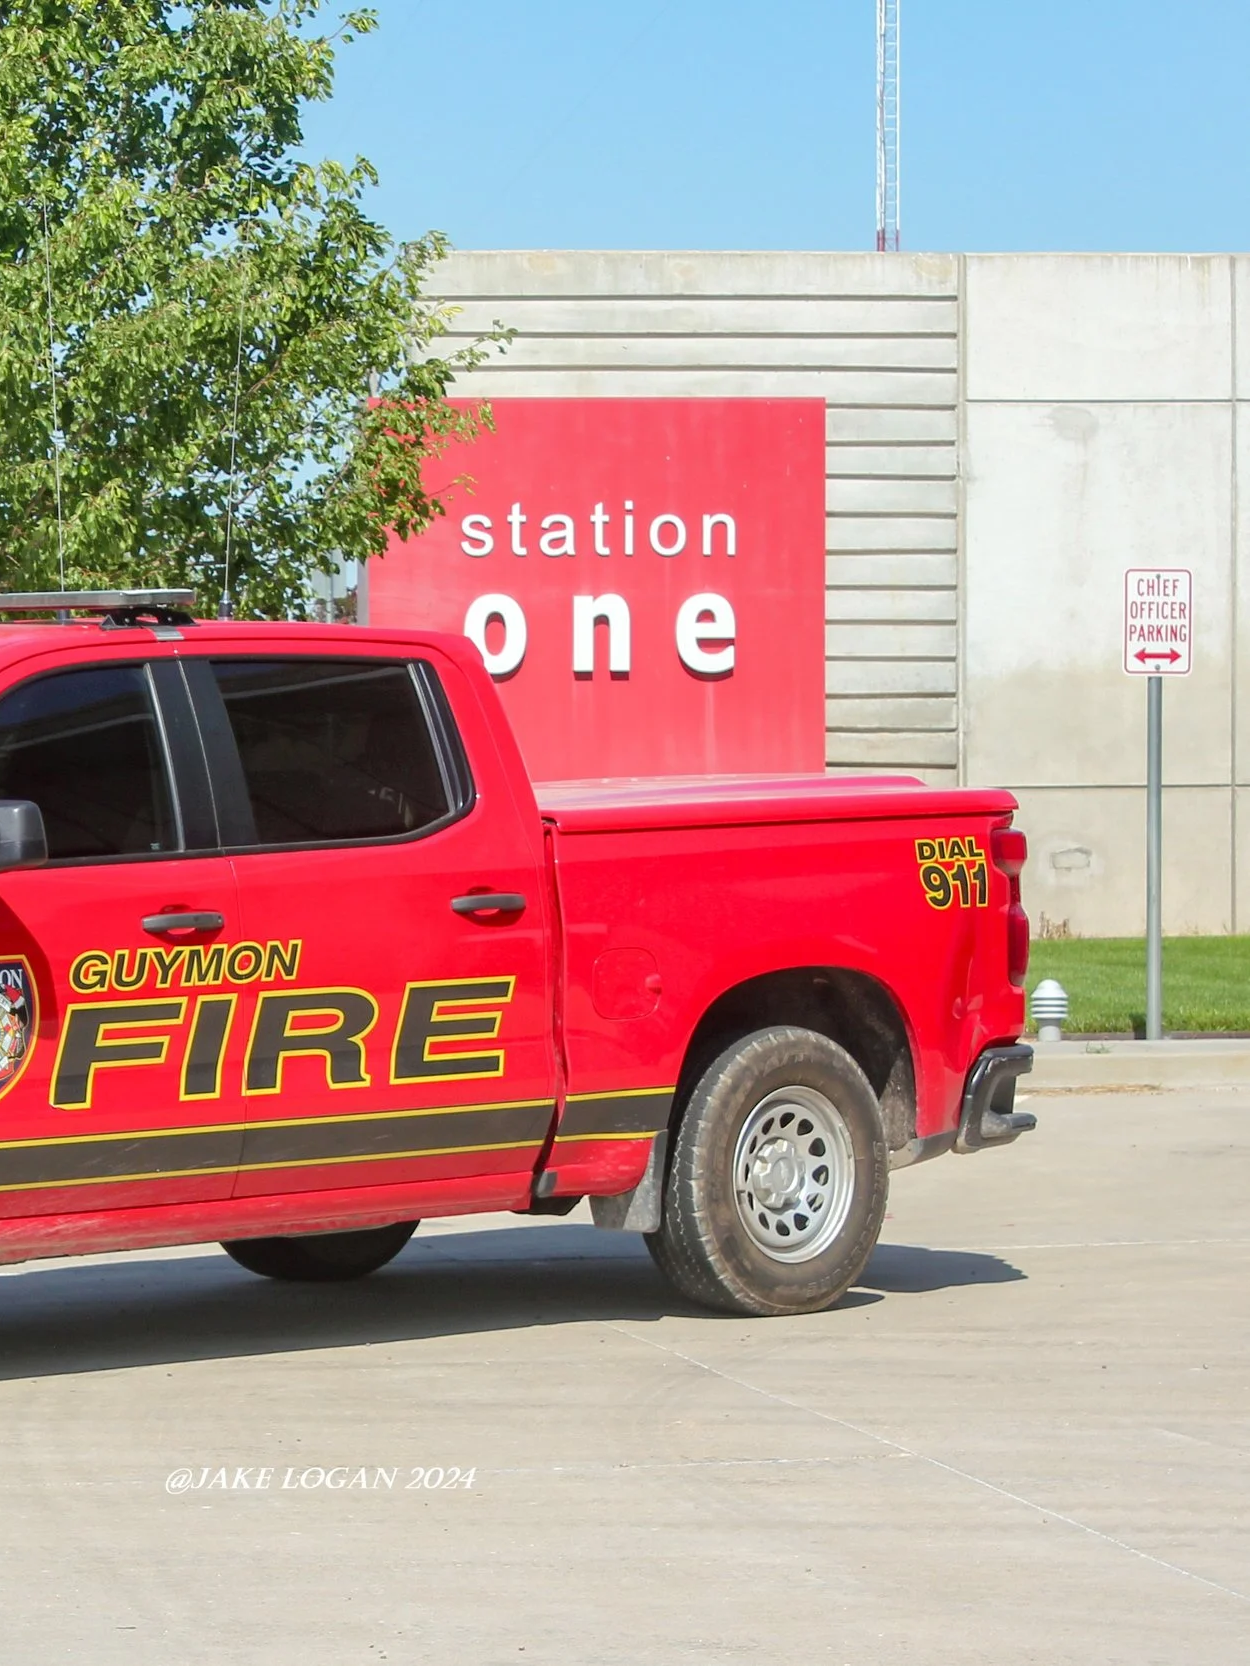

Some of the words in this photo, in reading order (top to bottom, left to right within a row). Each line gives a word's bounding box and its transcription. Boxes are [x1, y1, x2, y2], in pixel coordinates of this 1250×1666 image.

[460, 500, 737, 557] station
[1130, 601, 1187, 619] OFFICER
[1137, 578, 1179, 597] CHIEF
[463, 592, 736, 676] one
[1129, 624, 1187, 642] PARKING
[915, 836, 985, 863] DIAL
[920, 860, 988, 909] 911
[71, 939, 302, 991] GUYMON
[49, 975, 516, 1110] FIRE
